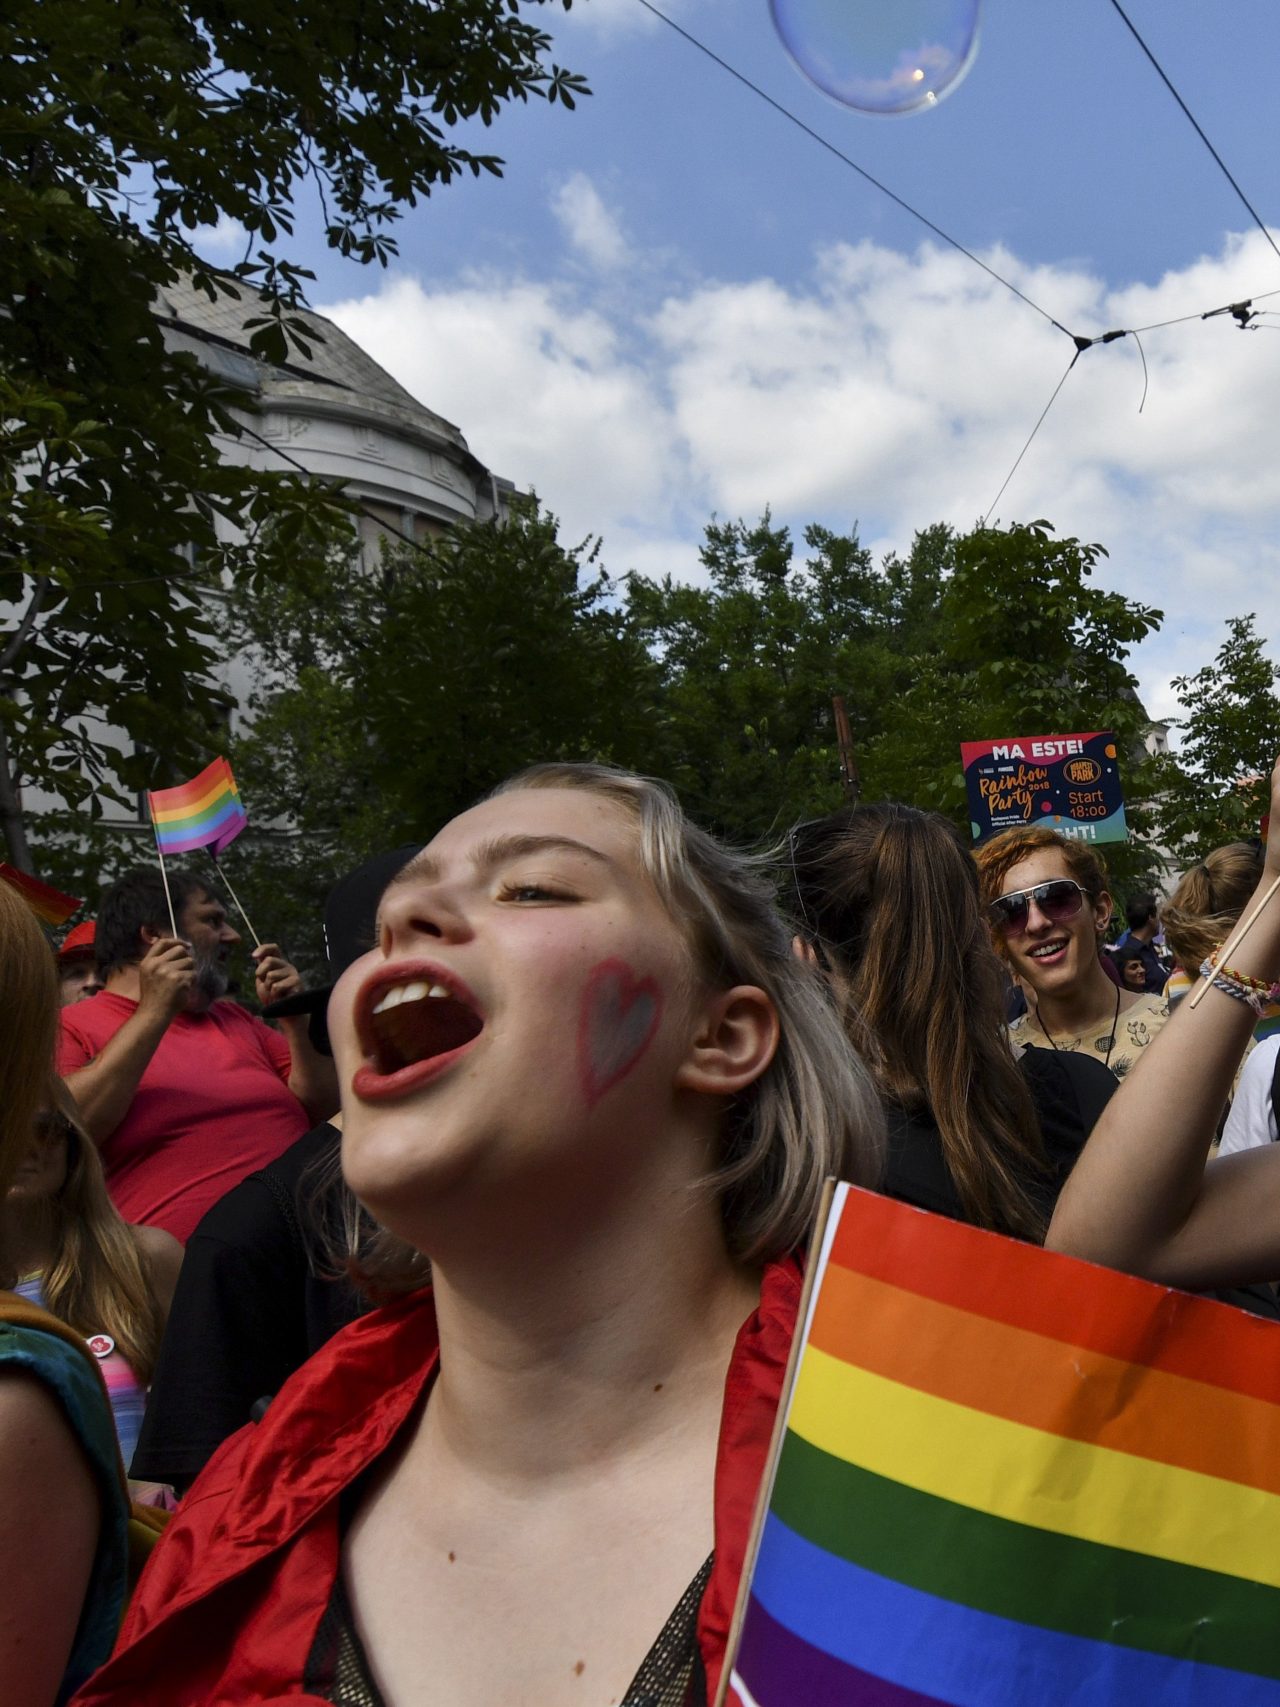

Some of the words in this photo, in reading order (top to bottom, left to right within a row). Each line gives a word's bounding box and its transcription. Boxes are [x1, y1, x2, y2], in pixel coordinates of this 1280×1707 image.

[992, 744, 1025, 760] MA
[1031, 739, 1084, 757] ESTE!
[980, 764, 1048, 798] Rainbow
[1071, 768, 1095, 781] PARK
[1028, 781, 1050, 791] 2018
[989, 787, 1035, 819] Party
[1068, 790, 1103, 804] Start
[1070, 805, 1107, 818] 18:00
